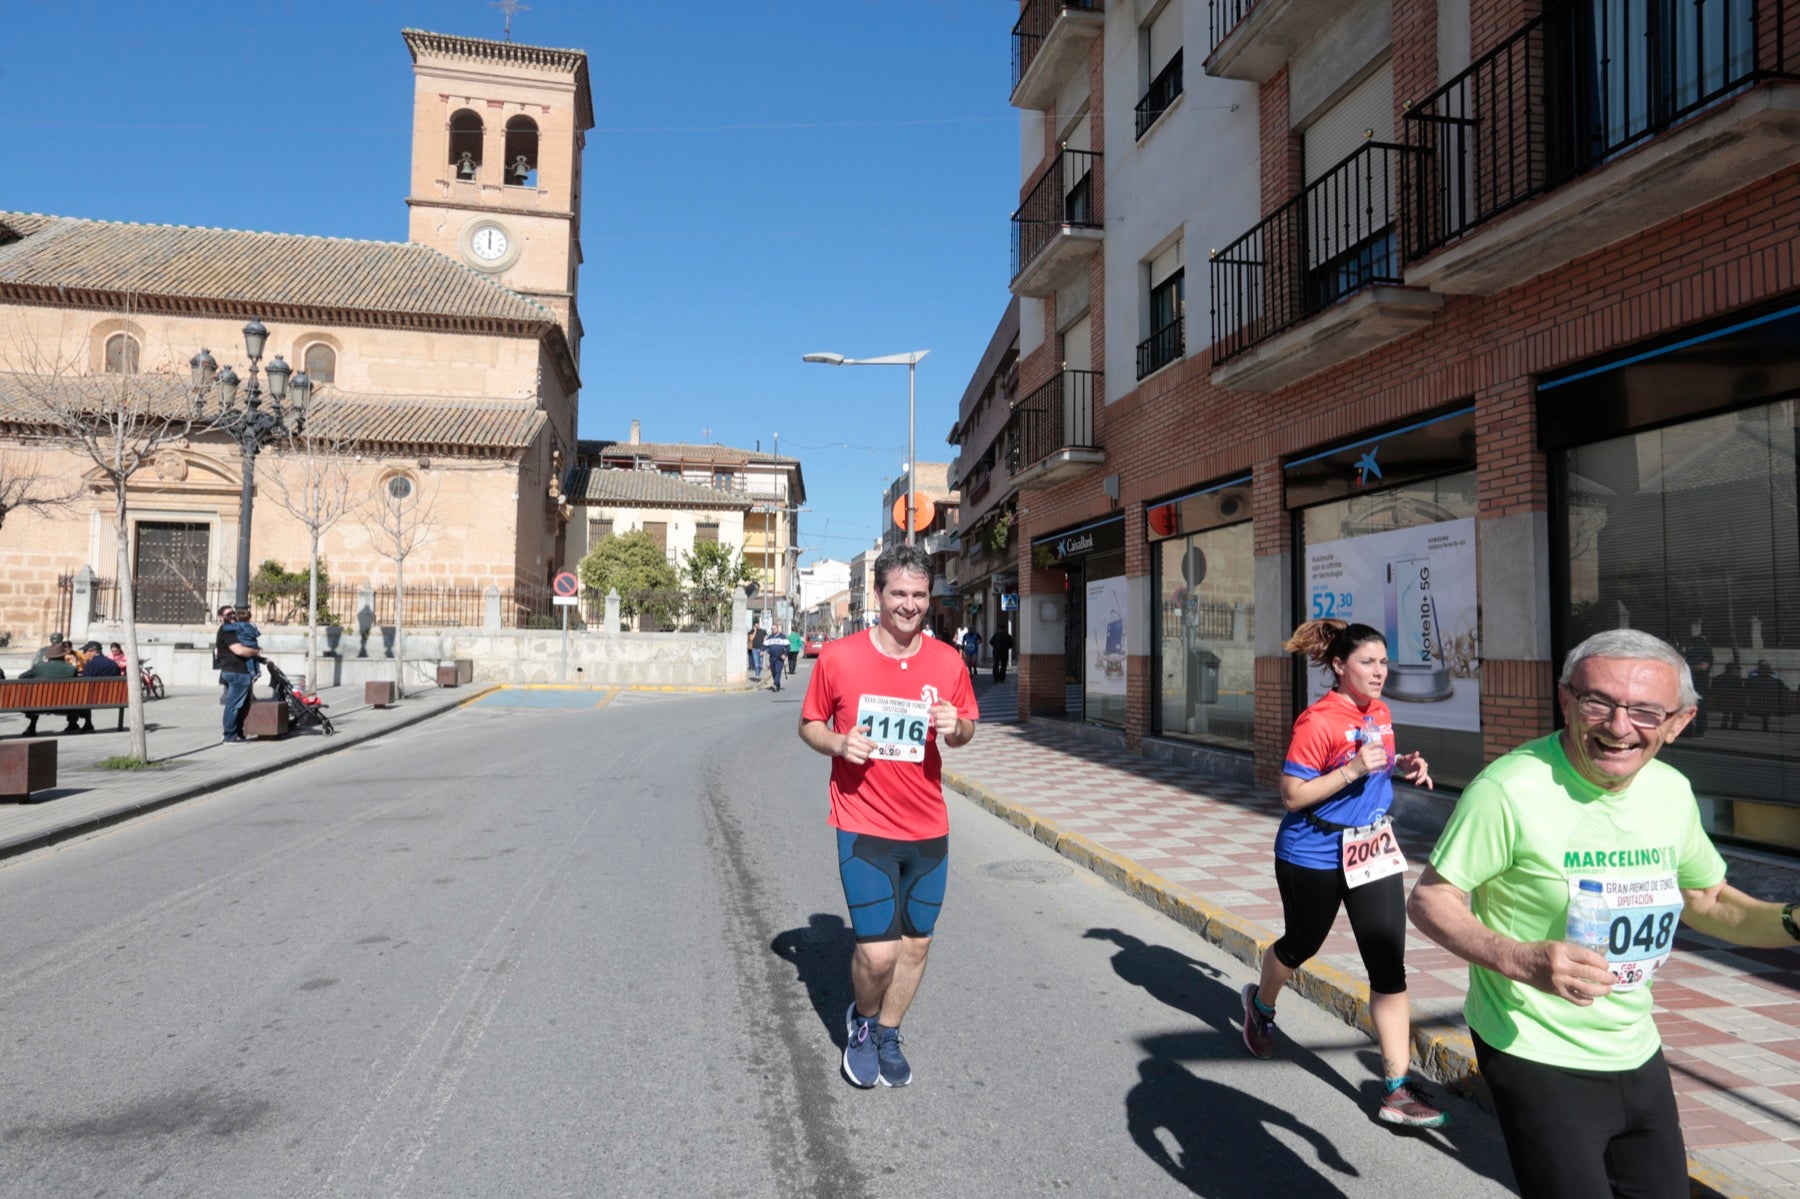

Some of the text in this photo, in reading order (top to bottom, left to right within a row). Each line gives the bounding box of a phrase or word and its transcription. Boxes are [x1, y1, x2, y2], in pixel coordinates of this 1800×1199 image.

[1066, 533, 1094, 553] CaixaBank
[1420, 567, 1431, 662] Note10+ 5G
[862, 715, 924, 741] 1116
[1347, 832, 1396, 867] 2002
[1564, 848, 1661, 868] MARCELINO
[1606, 882, 1628, 894] GRAN
[1629, 881, 1650, 893] PREMIO
[1651, 880, 1659, 891] DE
[1609, 912, 1674, 955] 048
